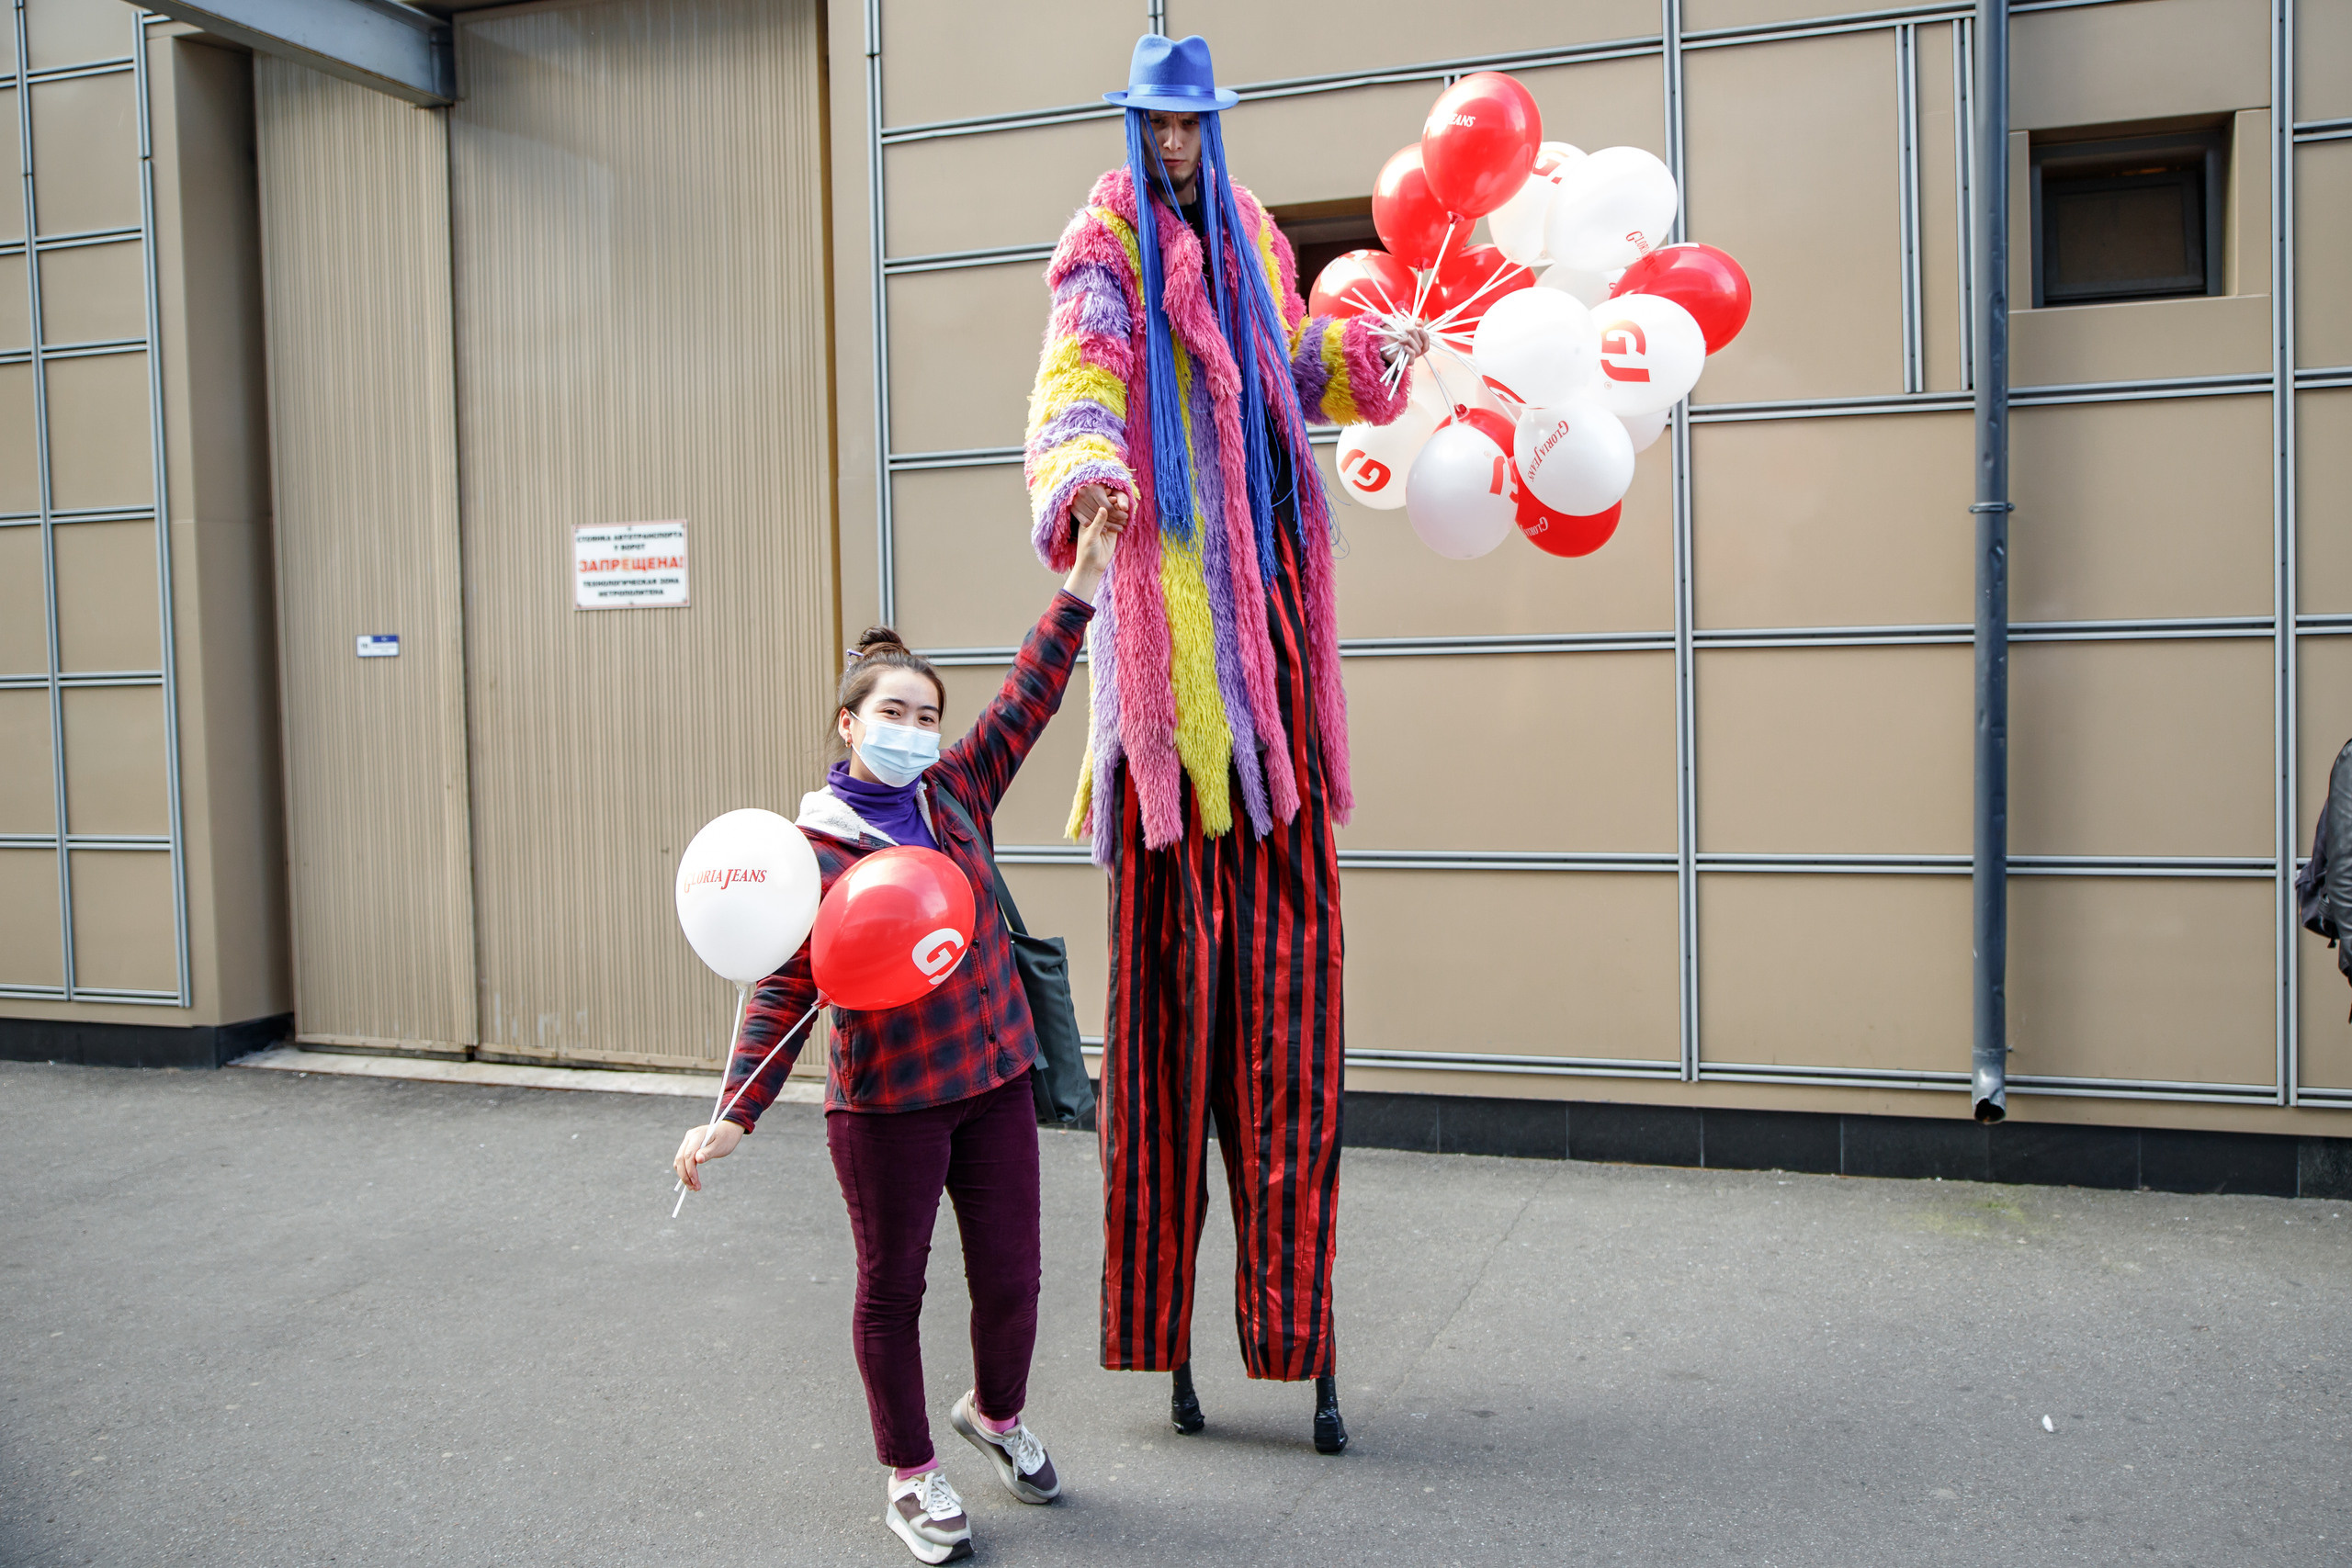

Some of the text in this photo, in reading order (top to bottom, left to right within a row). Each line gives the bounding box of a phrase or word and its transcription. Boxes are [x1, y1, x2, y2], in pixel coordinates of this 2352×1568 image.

[1448, 113, 1476, 128] EANS
[1600, 319, 1650, 382] GJ
[1539, 420, 1569, 457] GLORIA
[1340, 448, 1391, 492] GJ
[579, 555, 684, 572] ЗАПРЕЩЕНА!
[684, 868, 767, 894] GLORIA JEANS
